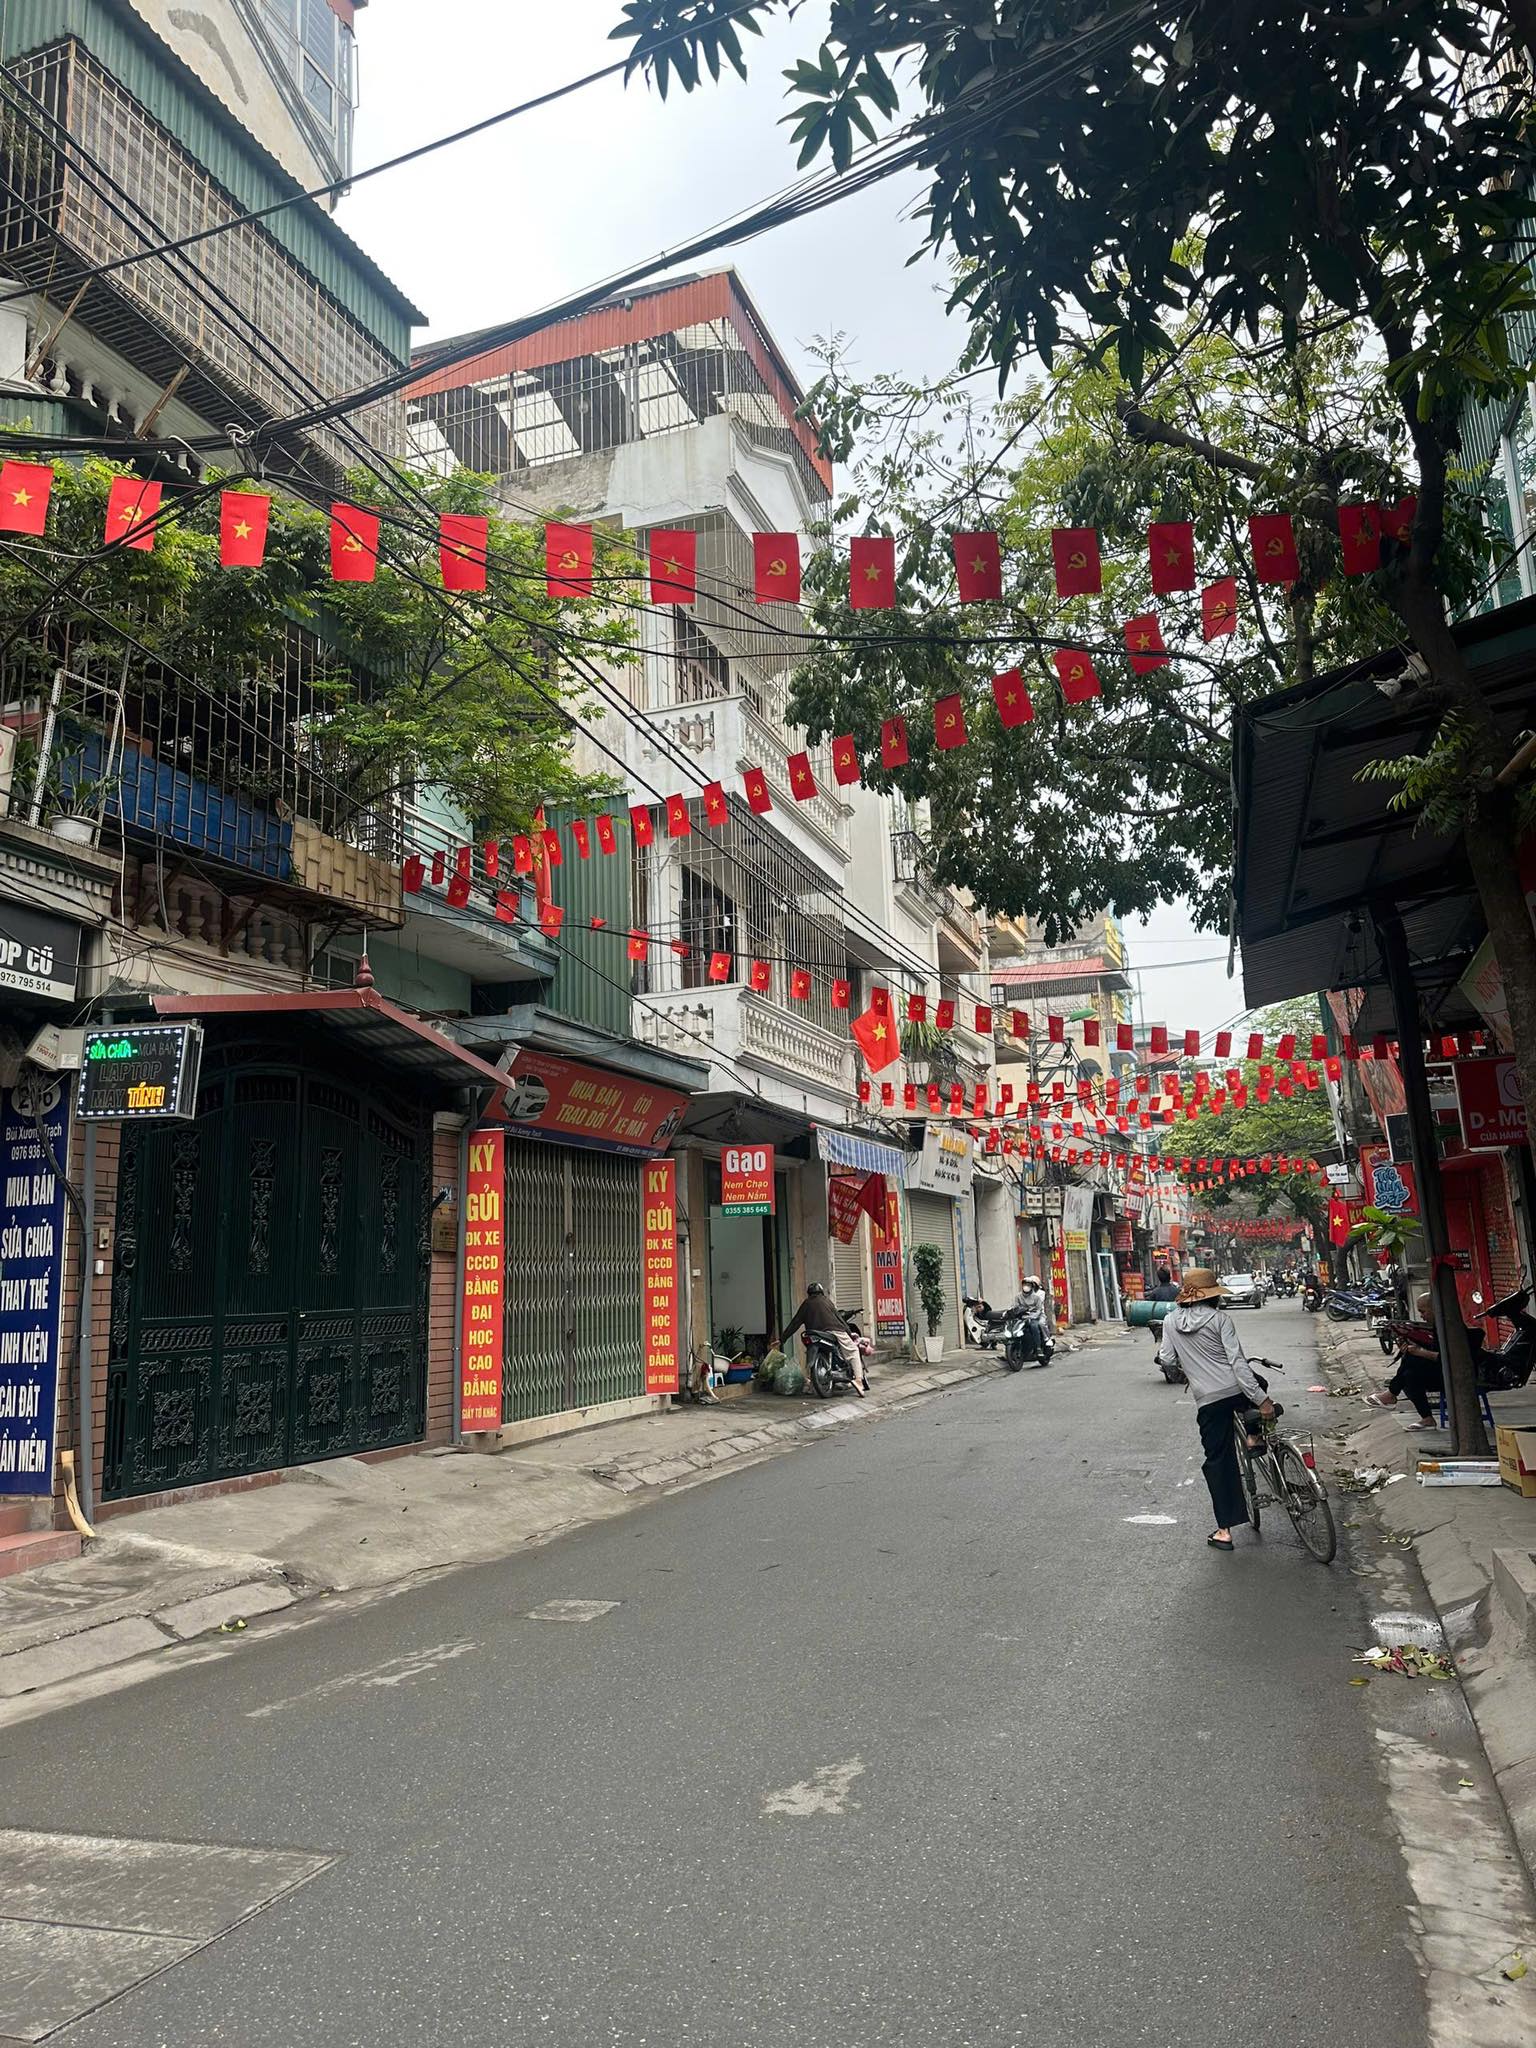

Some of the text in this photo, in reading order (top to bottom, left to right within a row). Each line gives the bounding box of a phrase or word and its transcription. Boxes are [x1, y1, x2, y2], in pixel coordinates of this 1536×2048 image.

[26, 945, 54, 976] CŨ
[18, 975, 34, 988] 795
[36, 980, 51, 992] 514
[101, 1061, 162, 1081] LAPTOP
[91, 1083, 126, 1109] MÁY
[567, 1080, 595, 1102] MUA
[593, 1084, 623, 1107] BÁN
[555, 1103, 584, 1127] TRAO
[612, 1117, 628, 1135] XE
[625, 1119, 649, 1139] MÁY
[1469, 1112, 1485, 1129] D
[11, 1146, 28, 1160] 0976
[28, 1144, 41, 1160] 936
[469, 1139, 496, 1173] KÝ
[726, 1150, 766, 1177] Gạo
[6, 1168, 55, 1207] MUA BÁN
[648, 1166, 668, 1193] KÝ
[724, 1180, 769, 1190] Nem Chạo
[466, 1184, 500, 1222] GỬI
[725, 1193, 746, 1201] Nem
[646, 1201, 673, 1232] GỬI
[742, 1206, 755, 1214] 385
[1, 1214, 54, 1260] SỬA CHỮA
[465, 1230, 500, 1246] ĐK XE
[646, 1238, 673, 1250] ĐK XE
[466, 1255, 499, 1271] CCCD
[647, 1257, 673, 1269] CCCD
[876, 1248, 899, 1268] MÁY
[1, 1266, 50, 1311] THAY THẾ
[465, 1275, 499, 1296] BẰNG
[647, 1273, 673, 1289] BẰNG
[882, 1272, 896, 1291] IN
[652, 1296, 669, 1310] ĐẠI
[877, 1298, 904, 1317] CAMERA
[471, 1305, 493, 1323] ĐẠI
[651, 1315, 671, 1330] HỌC
[22, 1324, 48, 1371] KIỆN
[469, 1330, 494, 1348] HỌC
[652, 1334, 671, 1347] CAO
[468, 1354, 493, 1371] CAO
[463, 1374, 497, 1397] ĐẲNG
[18, 1378, 41, 1425] ĐẶT
[18, 1428, 47, 1473] MỀM
